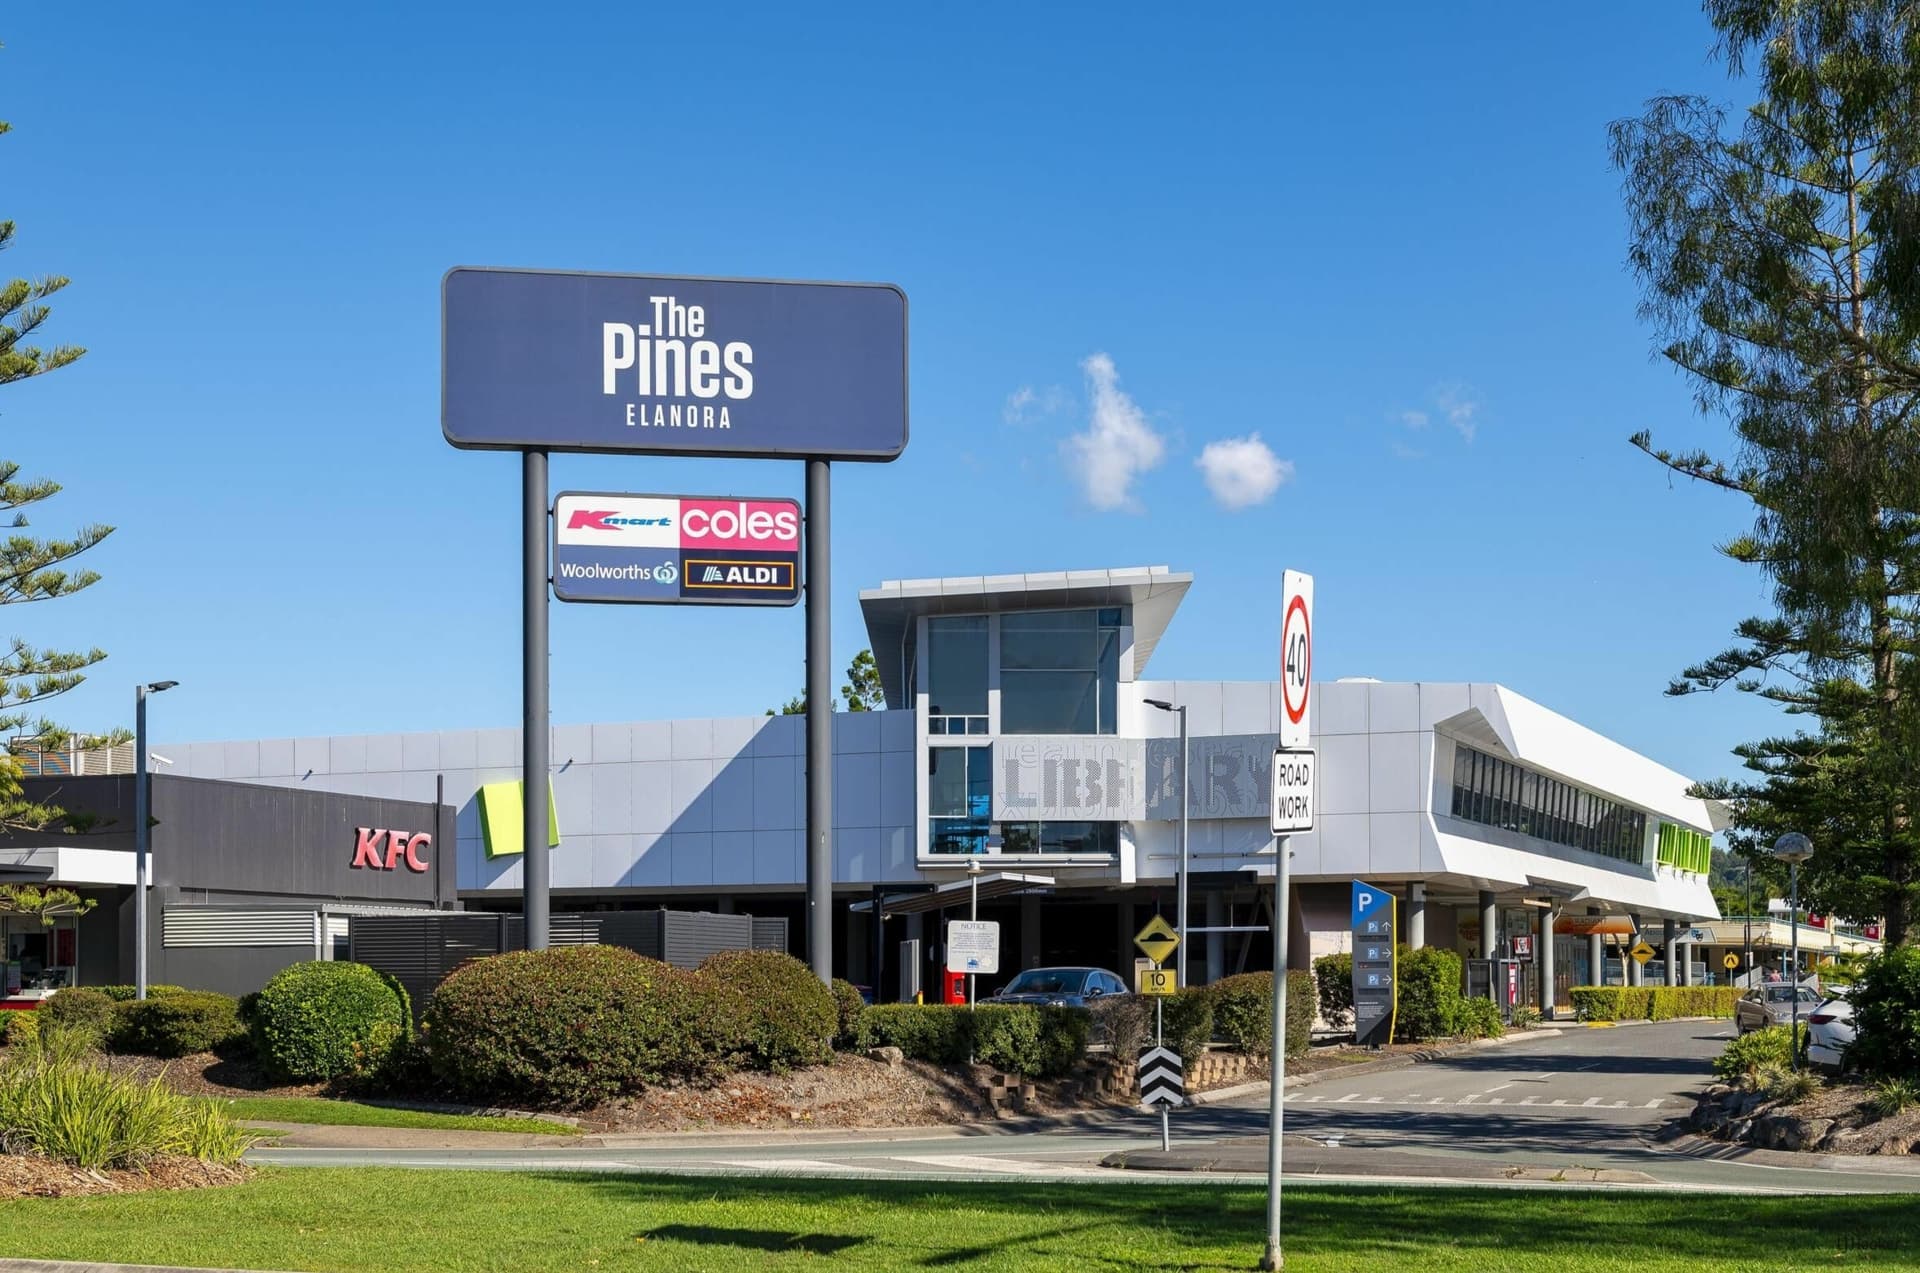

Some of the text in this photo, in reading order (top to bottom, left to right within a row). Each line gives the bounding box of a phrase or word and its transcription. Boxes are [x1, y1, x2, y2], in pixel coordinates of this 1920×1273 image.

[650, 296, 705, 337] The
[603, 322, 753, 400] Pines
[626, 403, 731, 429] ELANORA
[566, 510, 672, 531] Kmart
[682, 502, 798, 540] coles
[560, 562, 651, 580] Woolworths
[726, 566, 778, 584] ALDI
[1286, 632, 1307, 688] 40
[1279, 763, 1310, 787] ROAD
[1278, 795, 1309, 820] WORK
[351, 826, 432, 872] KFC
[1358, 892, 1373, 912] P
[1150, 973, 1166, 986] 10
